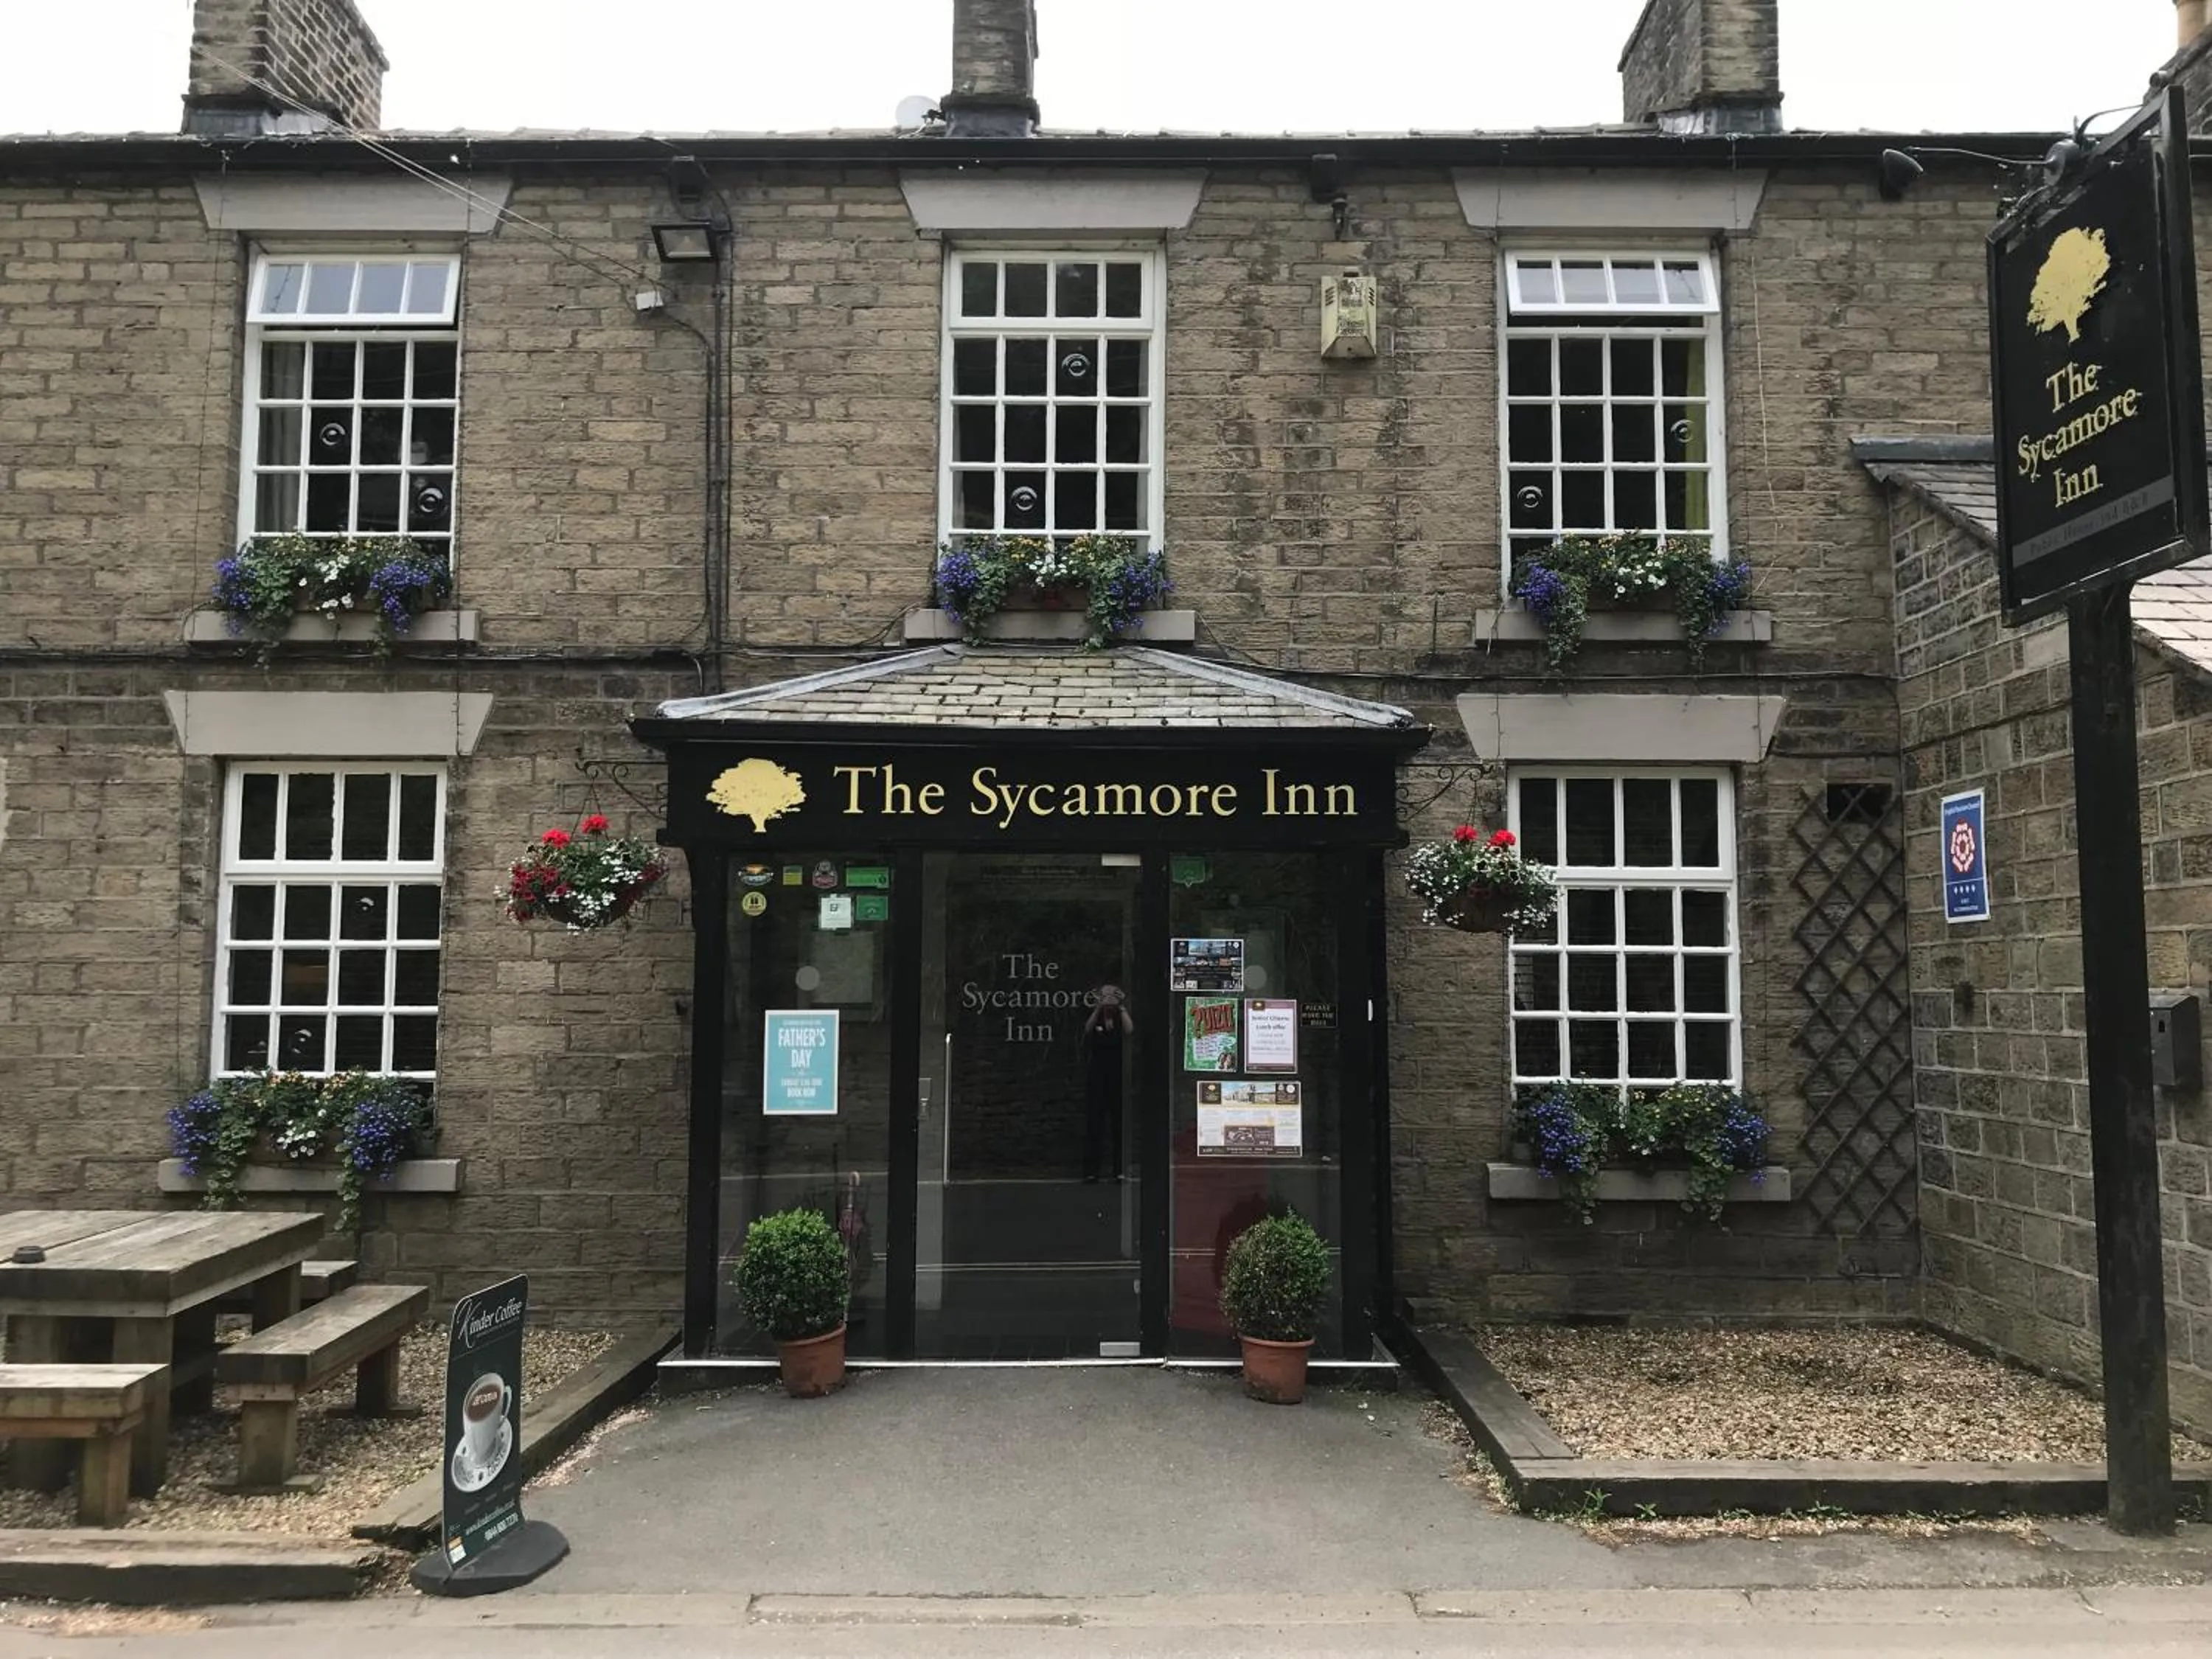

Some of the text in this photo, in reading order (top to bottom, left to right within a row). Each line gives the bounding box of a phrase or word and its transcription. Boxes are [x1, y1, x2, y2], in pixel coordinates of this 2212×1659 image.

[2045, 361, 2103, 413] The
[2017, 389, 2142, 483] Sycamore
[2053, 462, 2104, 508] Inn
[833, 764, 1358, 829] The Sycamore Inn
[1003, 953, 1060, 979] The
[962, 981, 1098, 1015] Sycamore
[778, 1028, 826, 1048] FATHER'S
[1005, 1017, 1053, 1041] Inn
[791, 1049, 812, 1068] DAY
[456, 1298, 495, 1349] Kinder
[495, 1297, 522, 1324] Coffee
